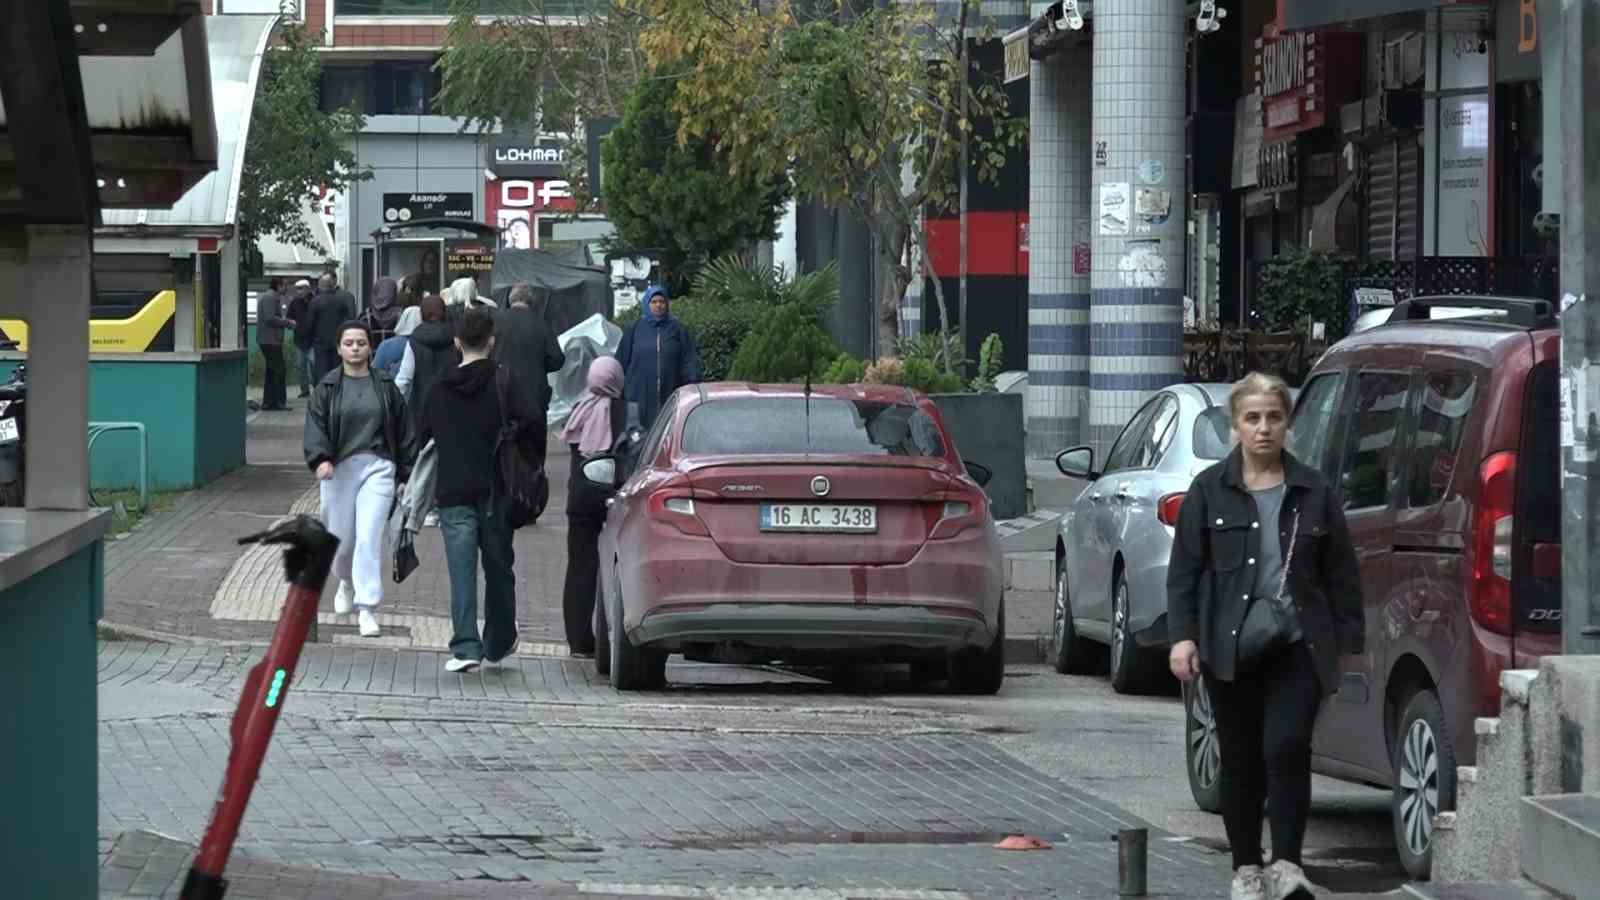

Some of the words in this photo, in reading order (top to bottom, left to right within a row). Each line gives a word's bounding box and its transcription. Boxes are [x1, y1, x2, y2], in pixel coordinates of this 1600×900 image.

[774, 506, 791, 524] 16
[800, 506, 821, 524] AC
[832, 507, 872, 525] 3438
